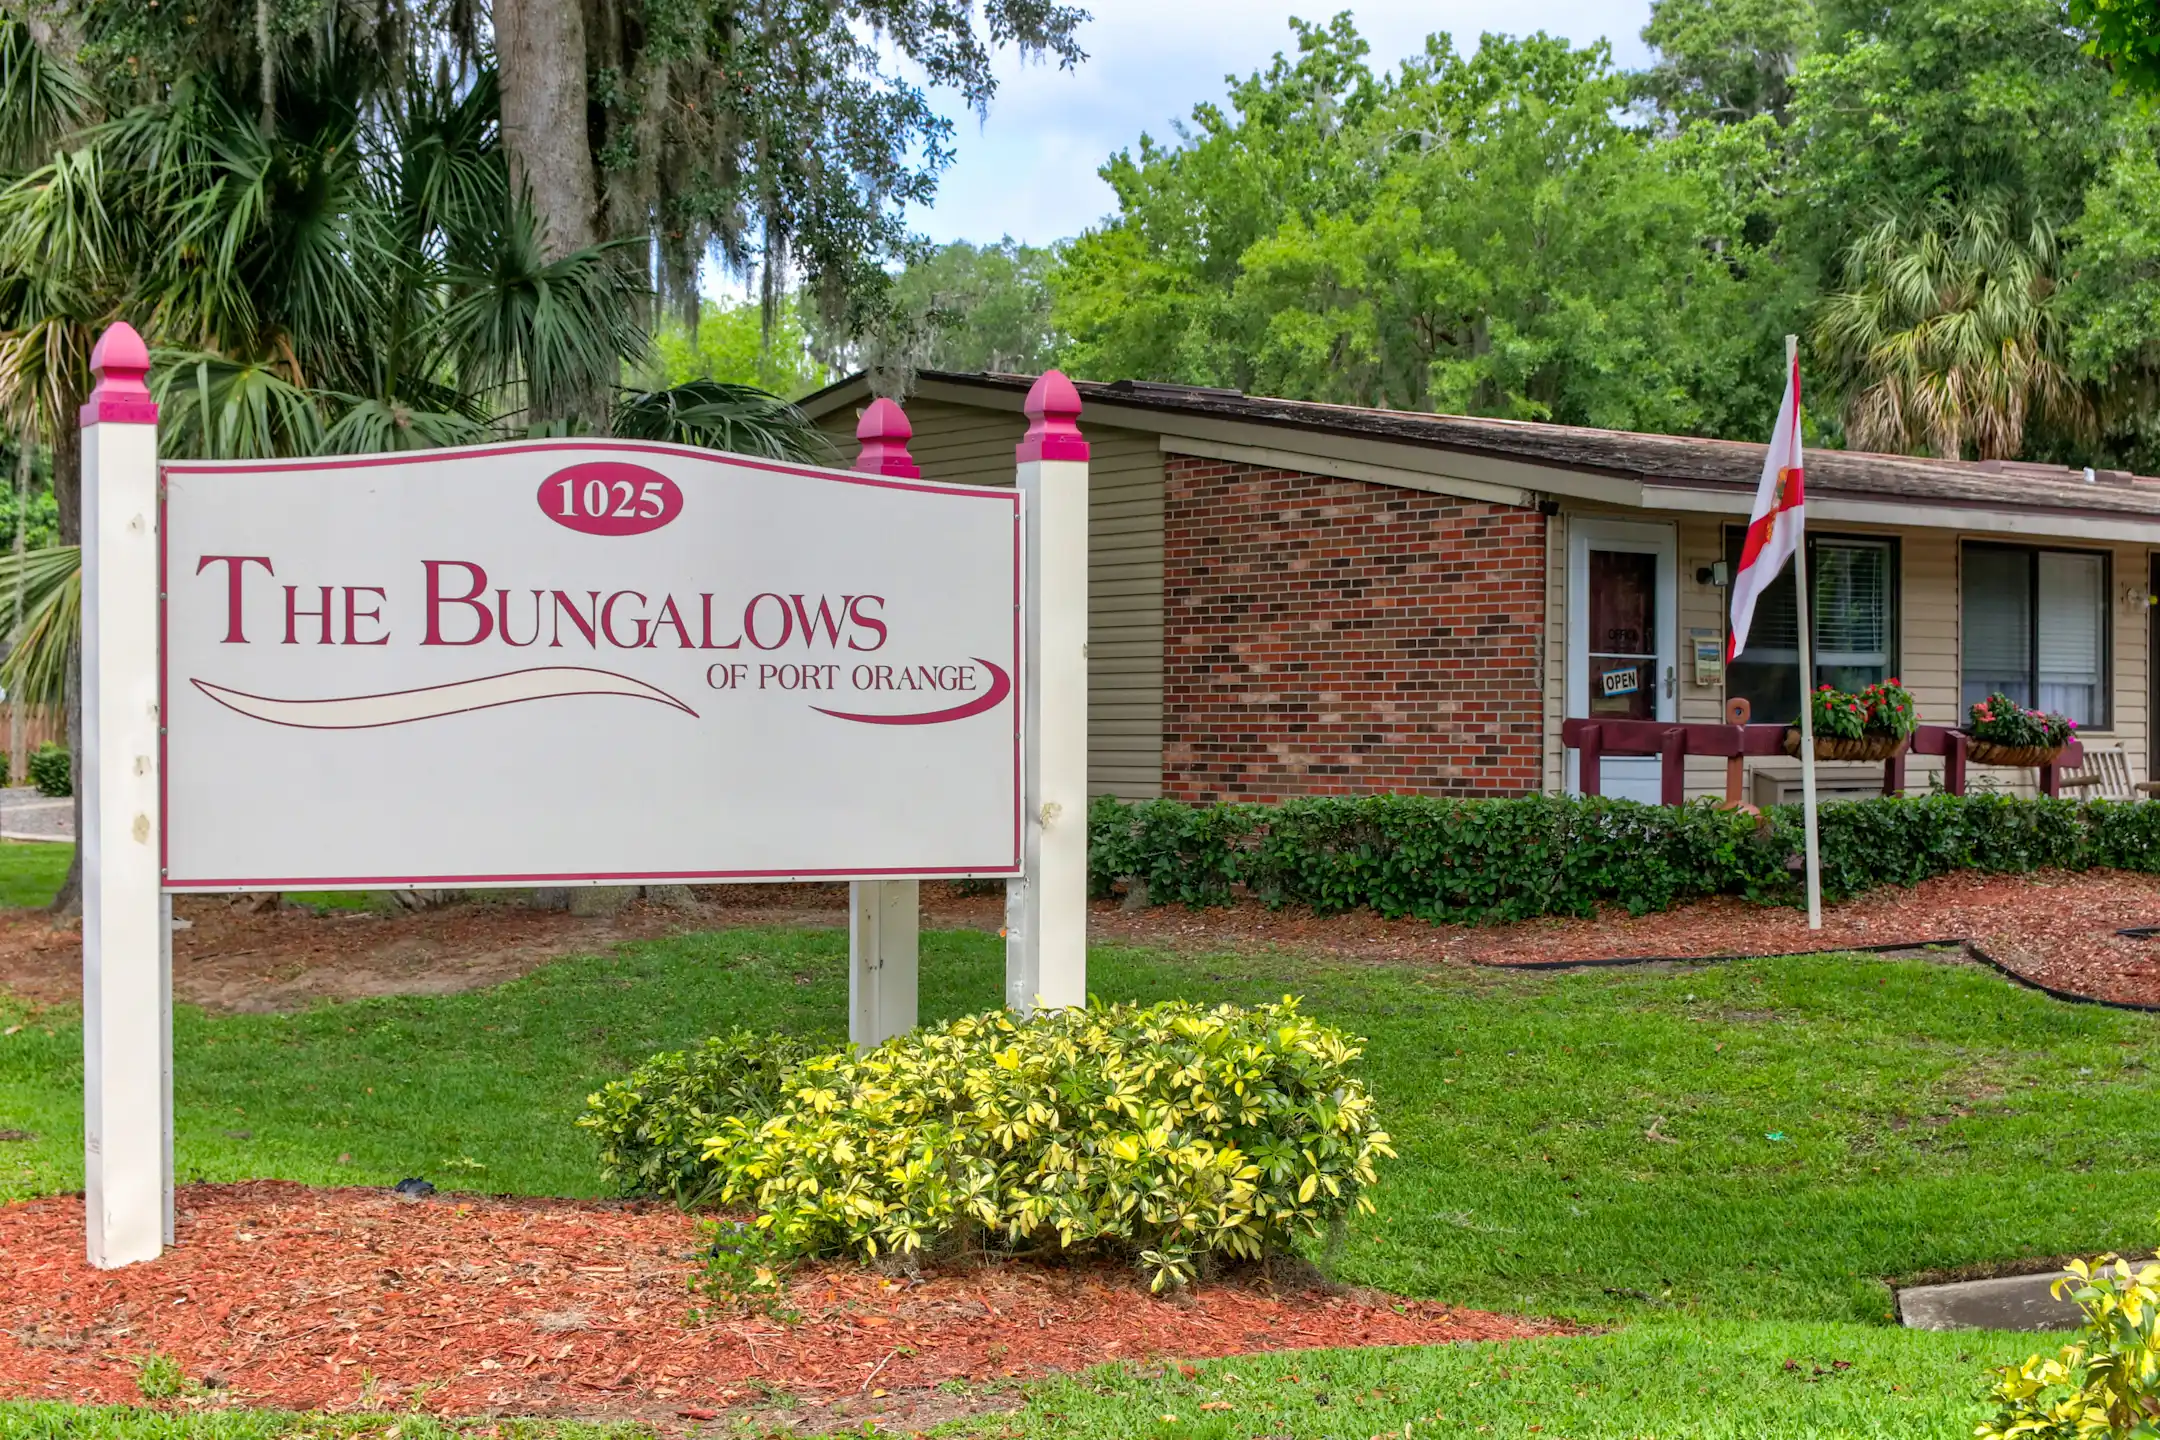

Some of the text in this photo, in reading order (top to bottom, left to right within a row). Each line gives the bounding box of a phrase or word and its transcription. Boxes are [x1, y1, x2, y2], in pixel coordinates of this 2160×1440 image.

[556, 478, 665, 519] 1025
[196, 555, 887, 651] THE BUNGALOWS
[706, 663, 977, 691] OF PORT ORANGE
[1606, 671, 1637, 690] OPEN
